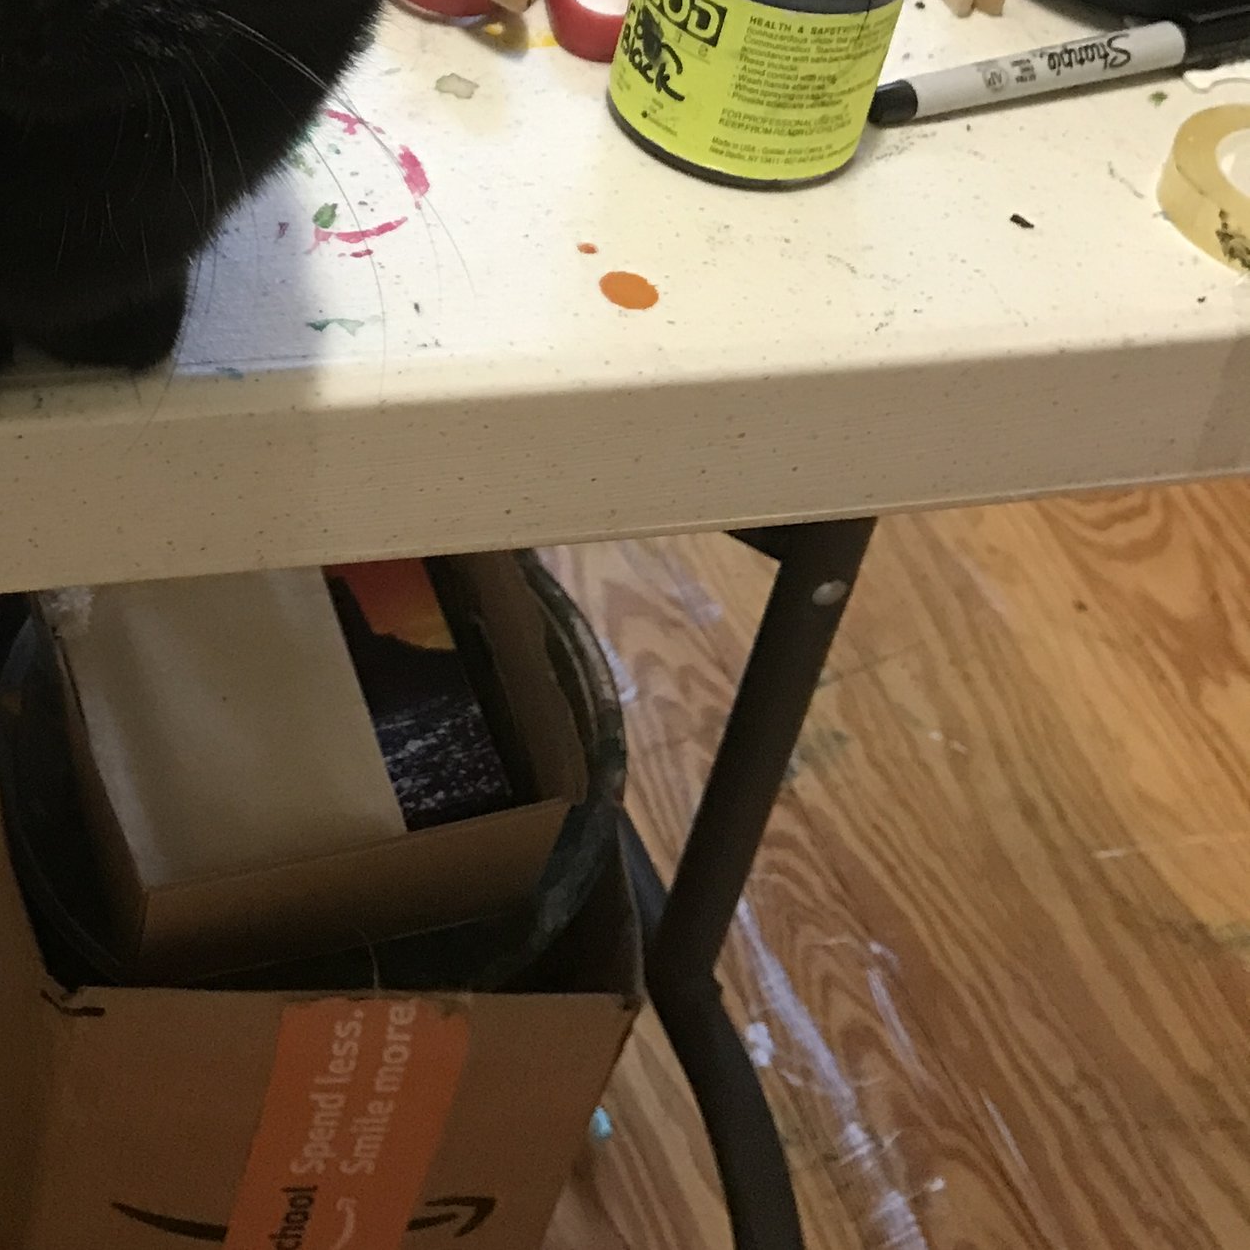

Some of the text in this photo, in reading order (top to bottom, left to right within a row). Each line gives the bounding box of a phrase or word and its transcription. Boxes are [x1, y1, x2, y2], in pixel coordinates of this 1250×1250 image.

[750, 16, 791, 33] HEALTH
[1047, 34, 1132, 76] Sharpie
[314, 1007, 364, 1086] less.
[290, 1091, 346, 1175] Spend
[338, 1099, 395, 1176] Smile
